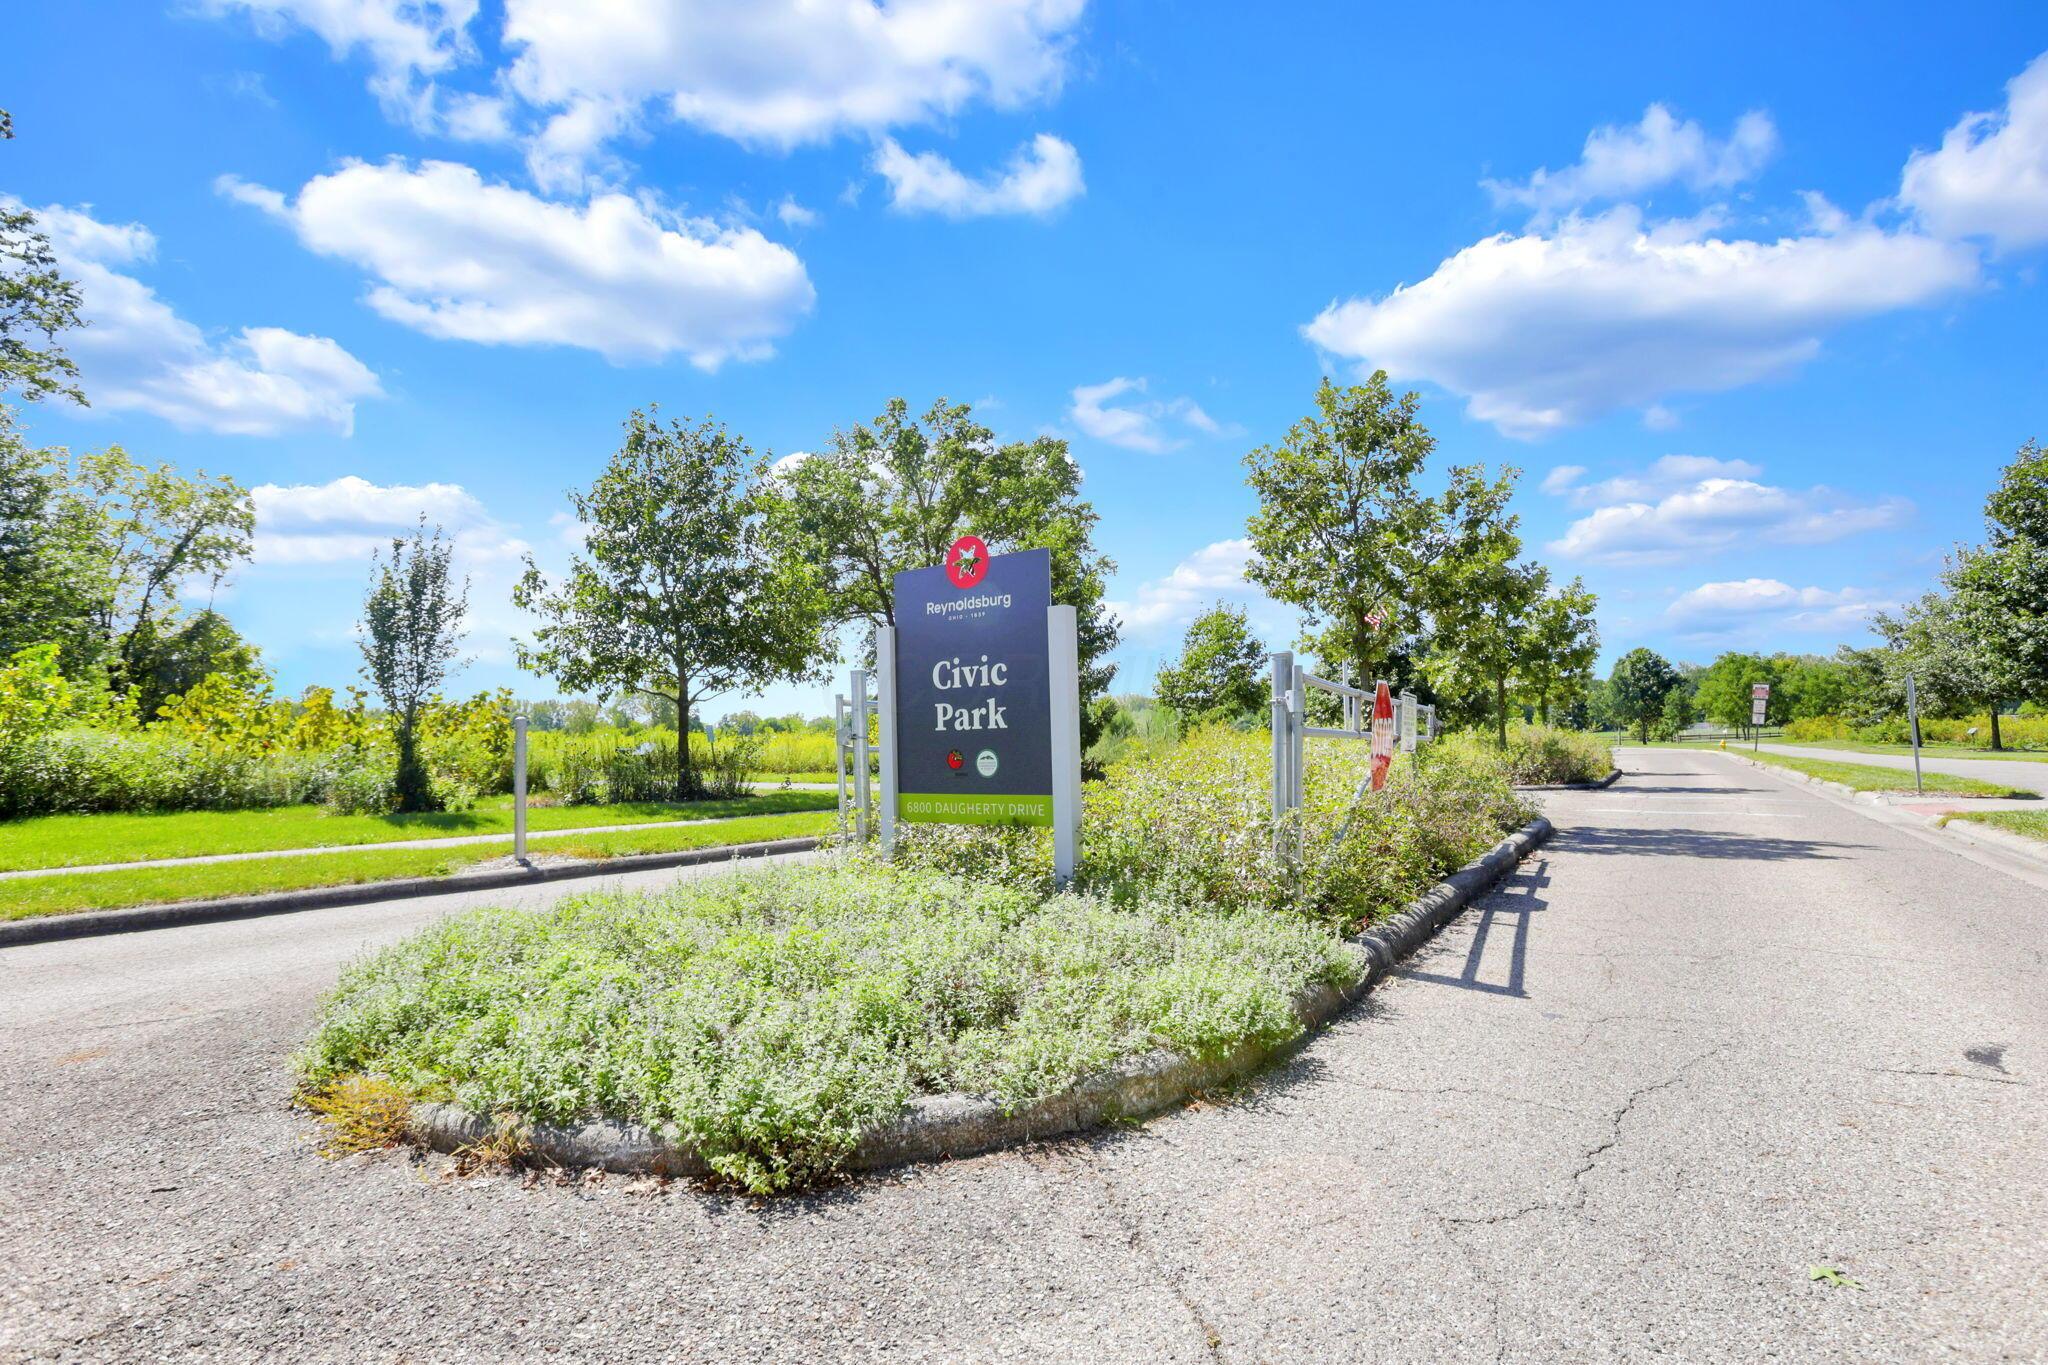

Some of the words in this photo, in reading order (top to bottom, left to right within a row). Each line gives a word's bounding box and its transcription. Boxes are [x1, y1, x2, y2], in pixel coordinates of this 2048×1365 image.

[926, 594, 1012, 615] Reynoldsburg
[932, 654, 1008, 690] Civic
[934, 698, 1008, 731] Park
[906, 801, 932, 814] 6800
[935, 802, 1005, 815] DAUGHERTY
[1008, 803, 1045, 817] DRIVE
